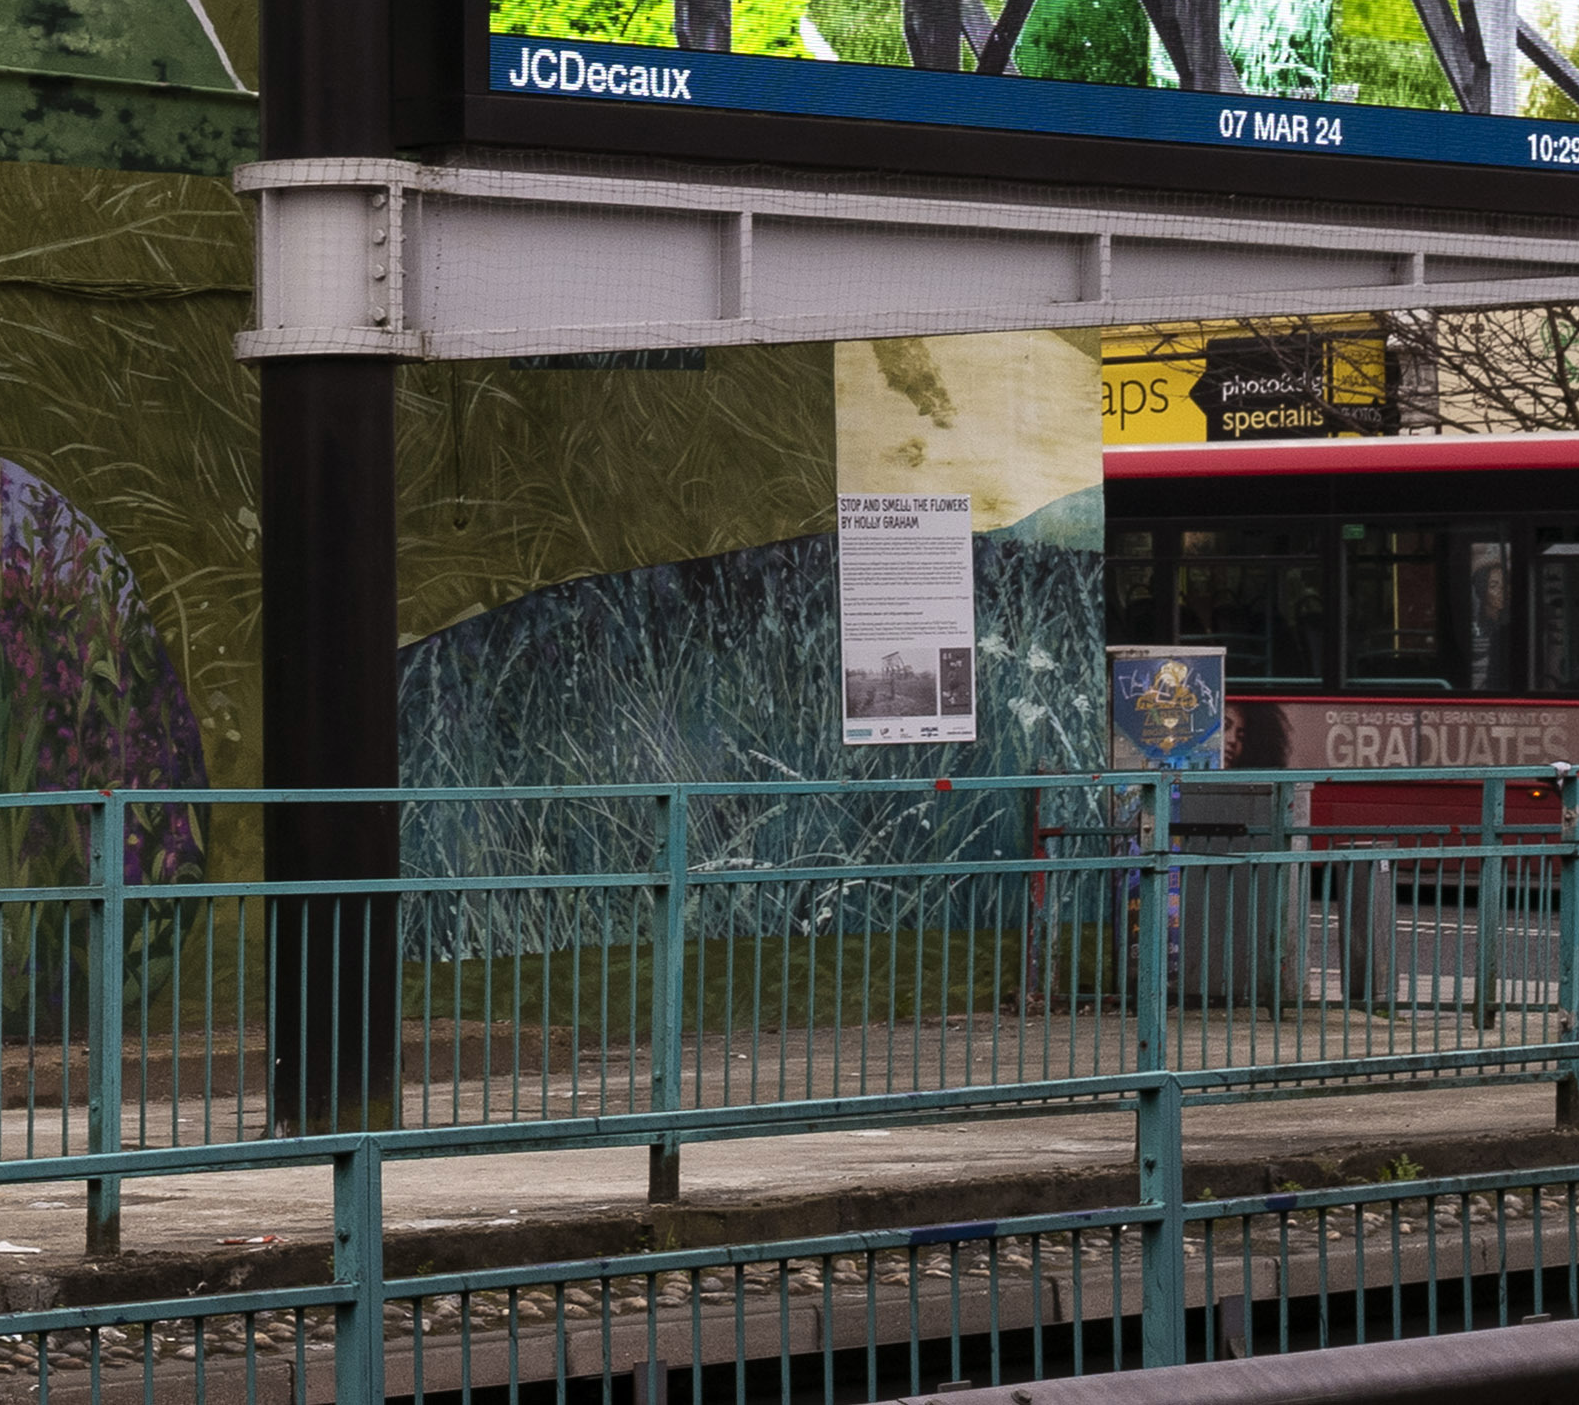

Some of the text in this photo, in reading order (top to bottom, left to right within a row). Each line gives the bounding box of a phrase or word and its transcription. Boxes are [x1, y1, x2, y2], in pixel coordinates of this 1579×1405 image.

[509, 47, 692, 100] JCDecaux
[1219, 109, 1343, 146] 07 MAR 24
[840, 498, 968, 512] STOP AND SMELL THE FLOWERS
[841, 516, 919, 529] BY HOLLY GRAHAM
[1326, 711, 1359, 724] OVER
[1444, 711, 1494, 724] BRANDS
[1497, 712, 1537, 724] WANT
[1326, 724, 1569, 767] GRADUATES
